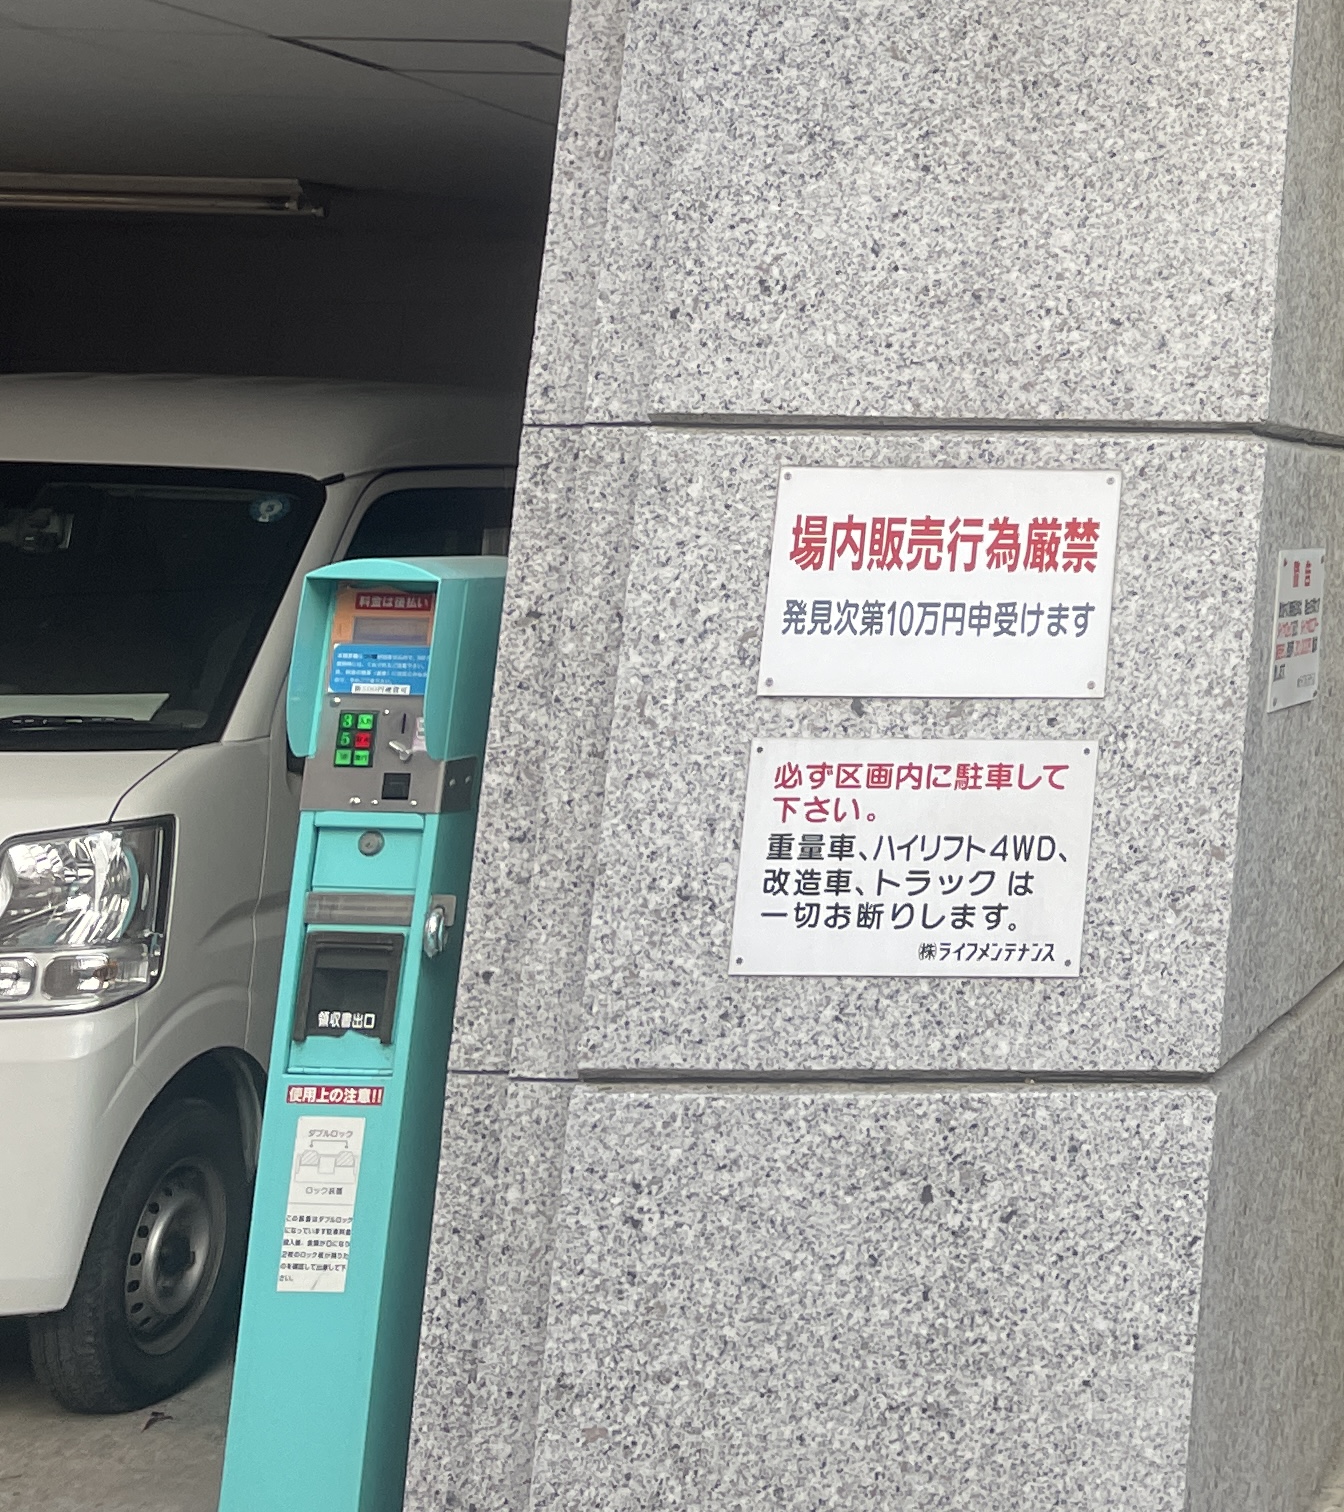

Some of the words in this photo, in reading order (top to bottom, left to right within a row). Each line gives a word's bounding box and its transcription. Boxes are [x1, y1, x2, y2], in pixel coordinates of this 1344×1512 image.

[789, 514, 1101, 574] 場内販売行為厳禁
[781, 598, 1096, 638] 発見次第10万円申受けます
[773, 761, 1070, 792] 必ず区画内に駐車して
[772, 795, 878, 824] 下さい。
[760, 901, 1019, 932] 一切お断りします。
[317, 1010, 376, 1030] 領収書出口
